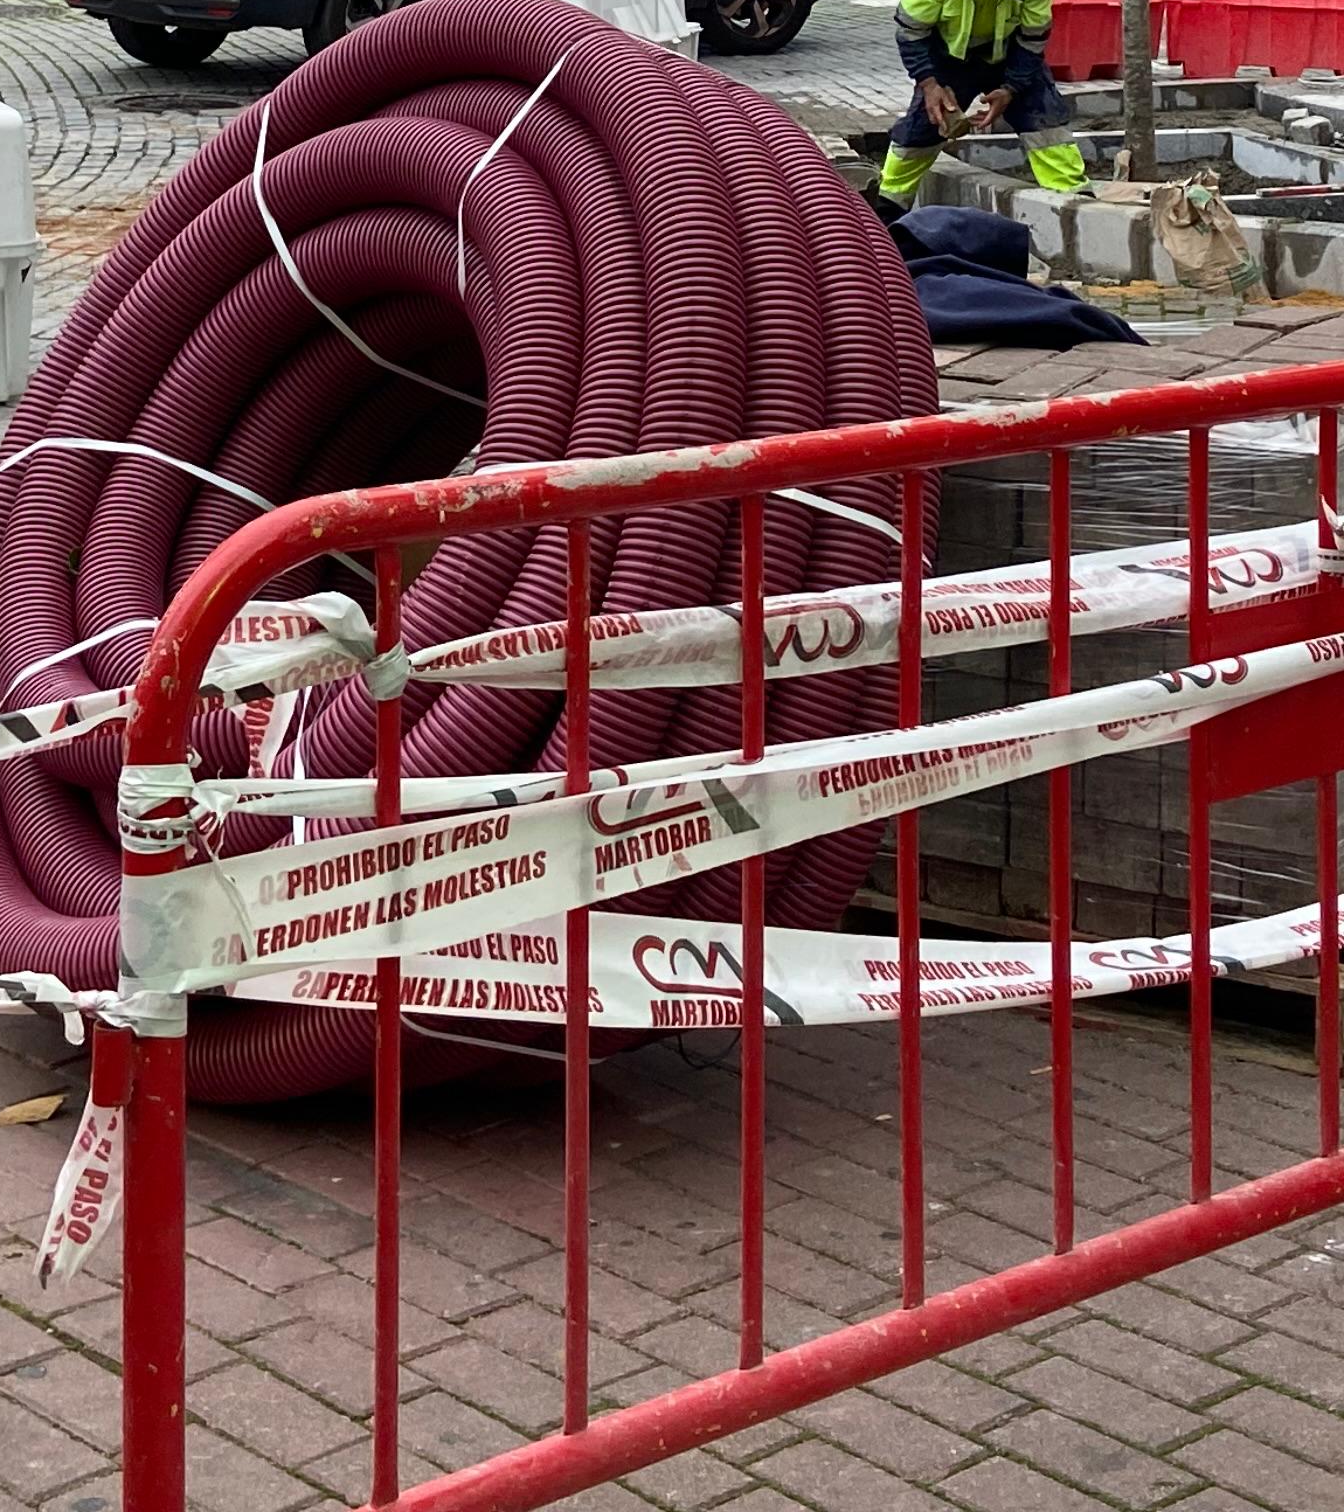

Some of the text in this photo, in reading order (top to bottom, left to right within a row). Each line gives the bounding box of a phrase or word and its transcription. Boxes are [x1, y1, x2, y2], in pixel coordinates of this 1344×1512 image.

[286, 813, 511, 900] PROHIBIDO EL PASO
[594, 814, 712, 875] MARTOBAR
[241, 850, 547, 962] ERDONEN LAS MOLESTIAS
[487, 933, 508, 962] EL
[510, 934, 559, 966] PASO
[961, 961, 985, 980] EL
[986, 959, 1036, 979] PASO
[447, 978, 490, 1010] LAS
[962, 984, 998, 1005] LAS
[66, 1167, 110, 1246] PASO
